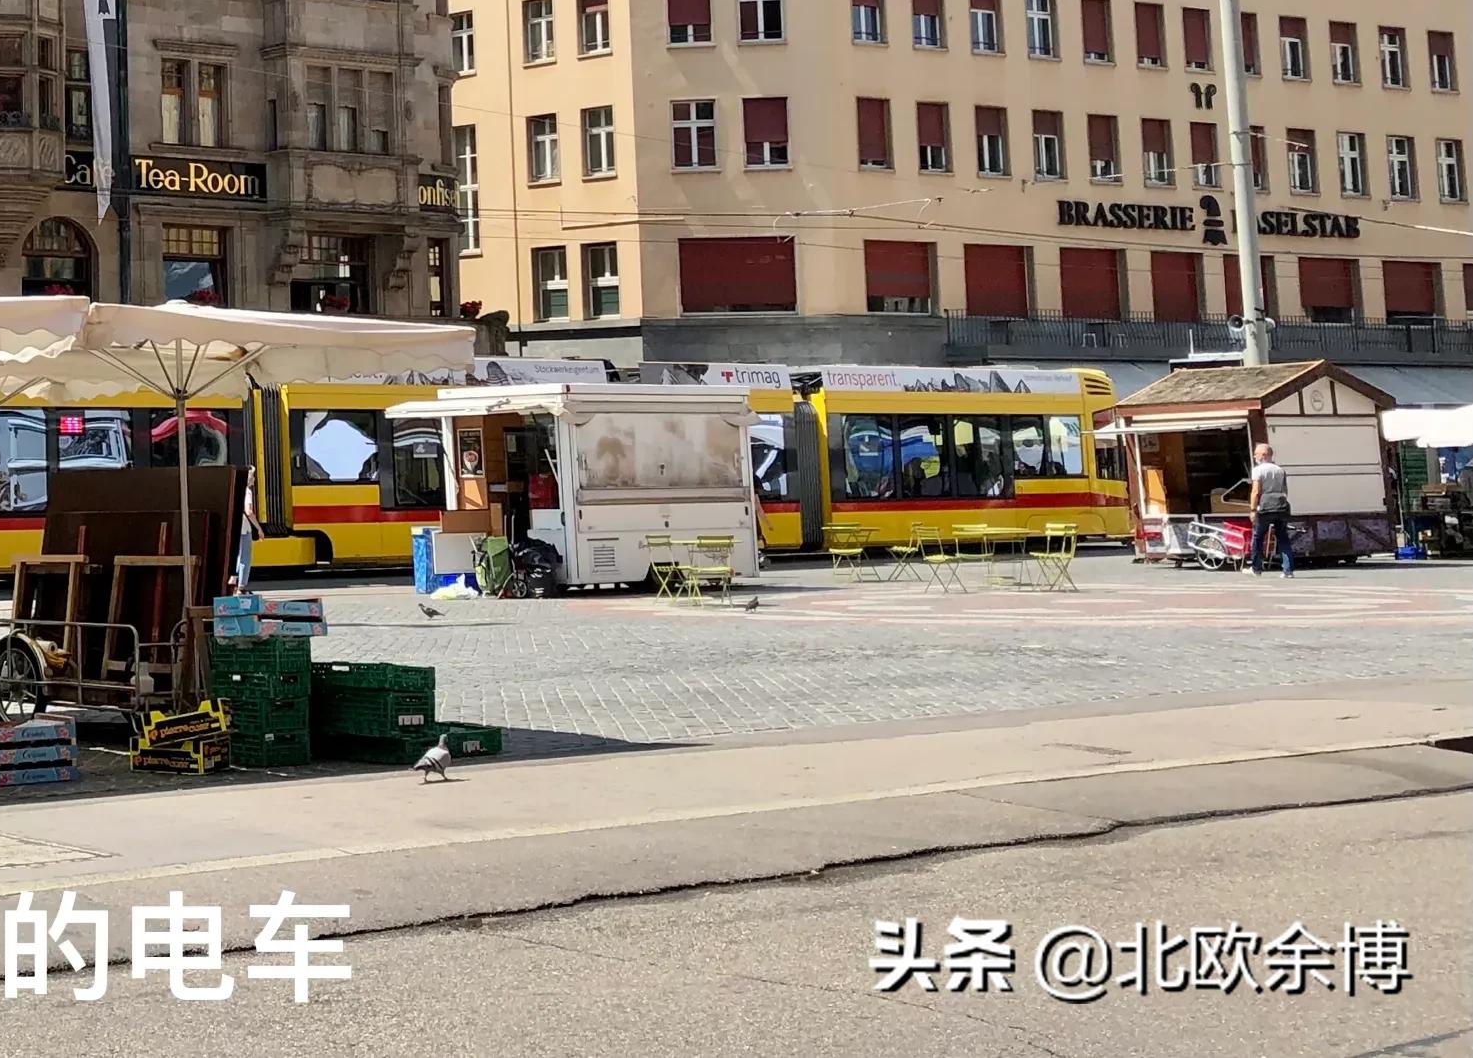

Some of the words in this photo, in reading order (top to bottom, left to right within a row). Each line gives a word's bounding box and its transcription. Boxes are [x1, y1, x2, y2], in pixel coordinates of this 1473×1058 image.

[134, 159, 260, 195] Tea-Room
[1057, 200, 1195, 231] BRASSERIE
[1230, 209, 1361, 239] SELSTAB
[734, 367, 781, 388] trimag
[828, 370, 902, 388] transparent.
